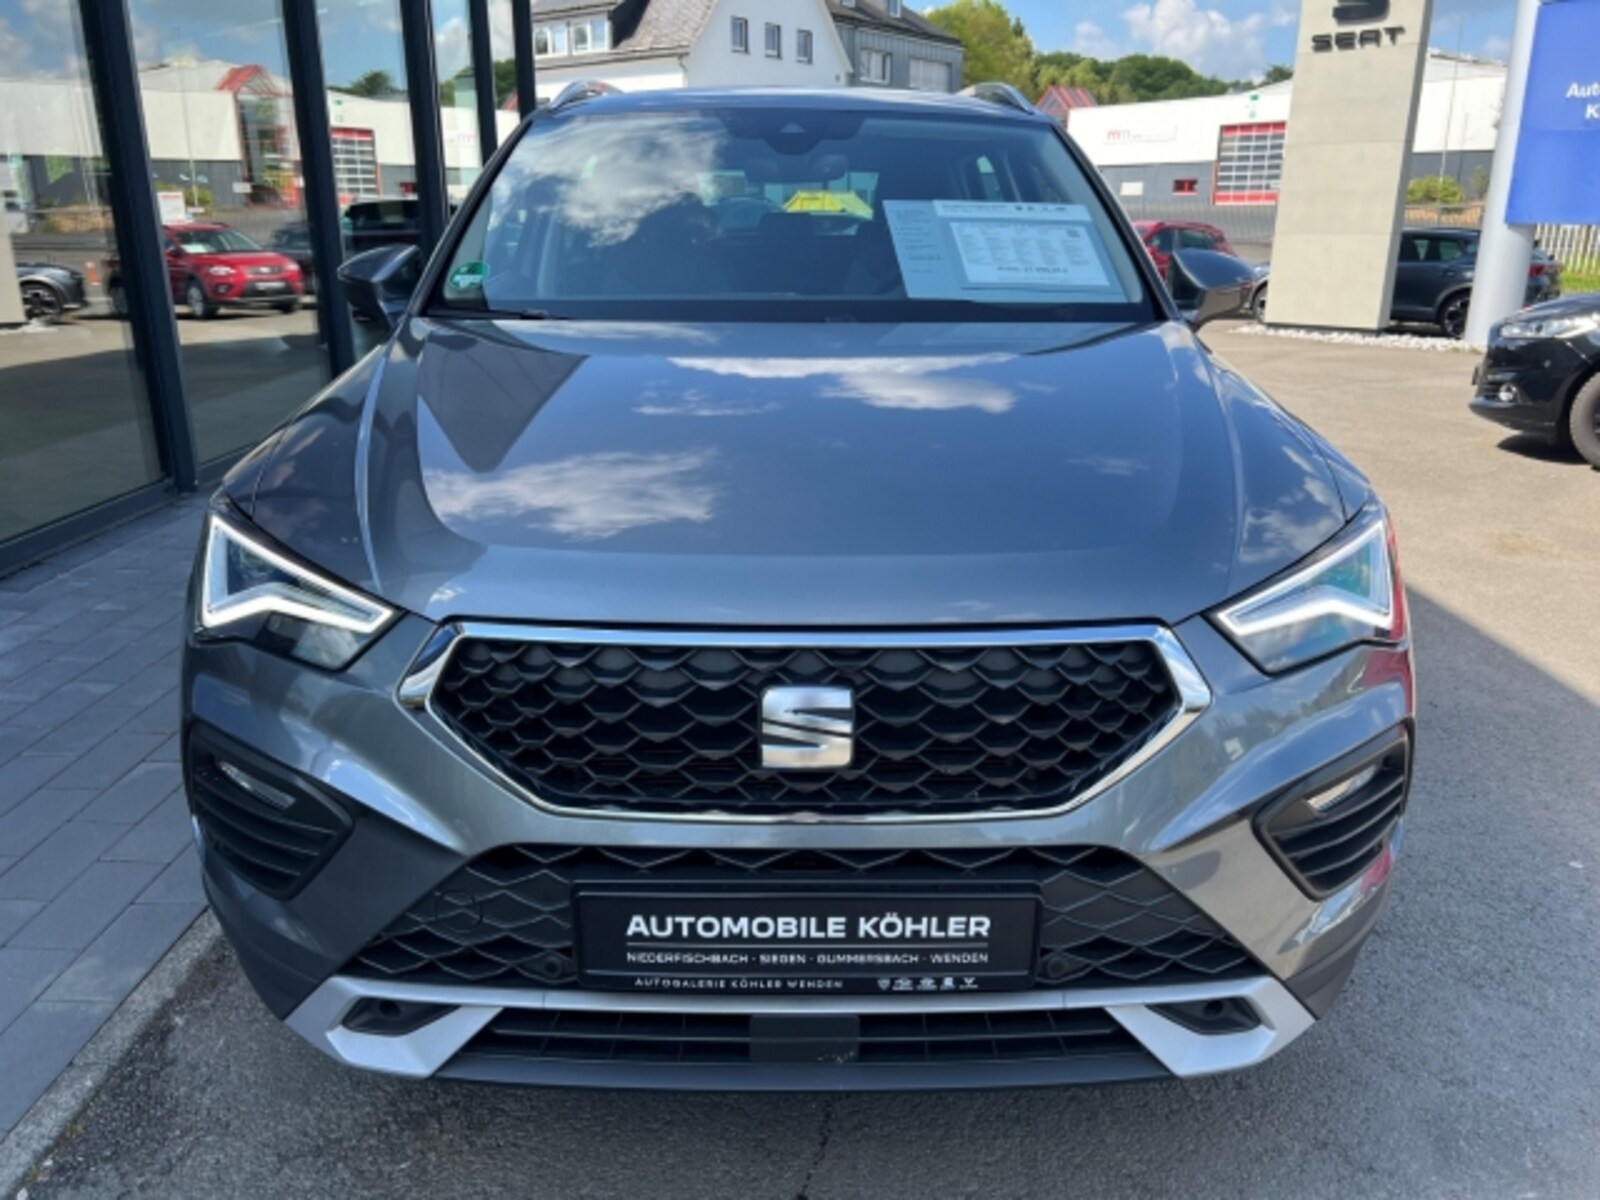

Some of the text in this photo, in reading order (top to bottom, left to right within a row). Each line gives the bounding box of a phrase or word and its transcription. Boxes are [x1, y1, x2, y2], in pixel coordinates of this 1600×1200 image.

[1311, 26, 1406, 52] SEAT
[626, 912, 991, 938] AUTOMOBILE KÖHLER
[930, 952, 988, 964] WENDEN
[634, 977, 843, 988] AUTOGALERIE KÖHLER WENDEN
